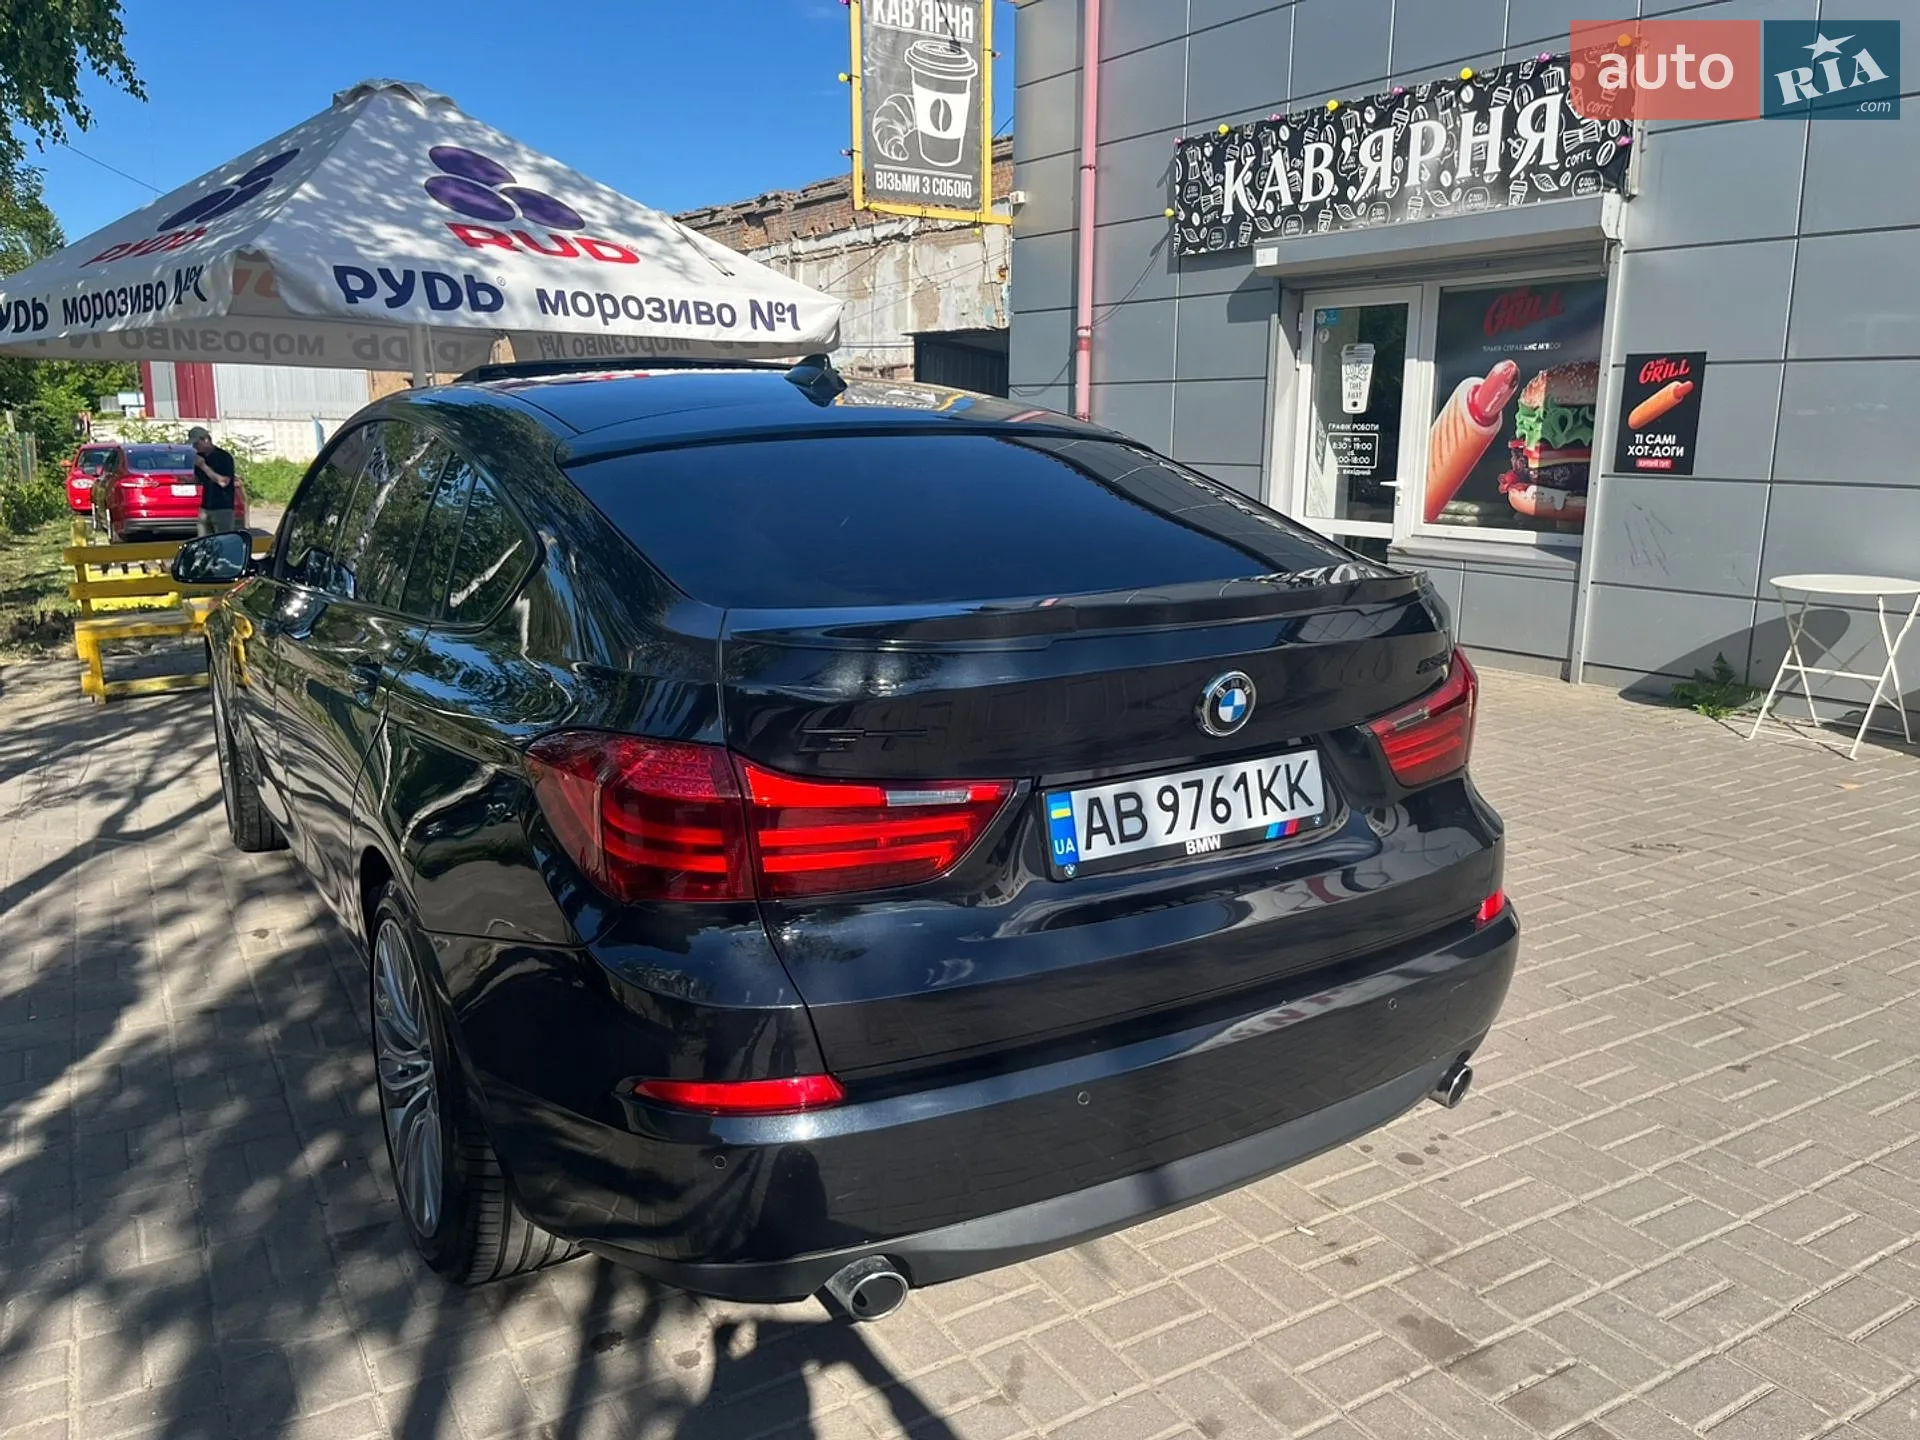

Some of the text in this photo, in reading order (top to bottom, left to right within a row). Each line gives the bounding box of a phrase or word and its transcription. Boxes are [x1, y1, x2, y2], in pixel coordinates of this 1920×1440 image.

[1221, 92, 1564, 218] КАВ'ЯРНЯ
[875, 171, 973, 199] ВІЗЬМИ З СОБОЮ
[445, 222, 641, 264] RUD
[749, 298, 801, 332] №1
[1639, 359, 1690, 384] GRILL
[1352, 423, 1380, 431] РОБОТИ
[1635, 434, 1676, 445] ТІ САМІ
[1627, 445, 1685, 457] ХОТ-ДОГИ
[1085, 791, 1148, 850] AB
[1054, 837, 1076, 855] UA
[1185, 835, 1222, 855] BMW
